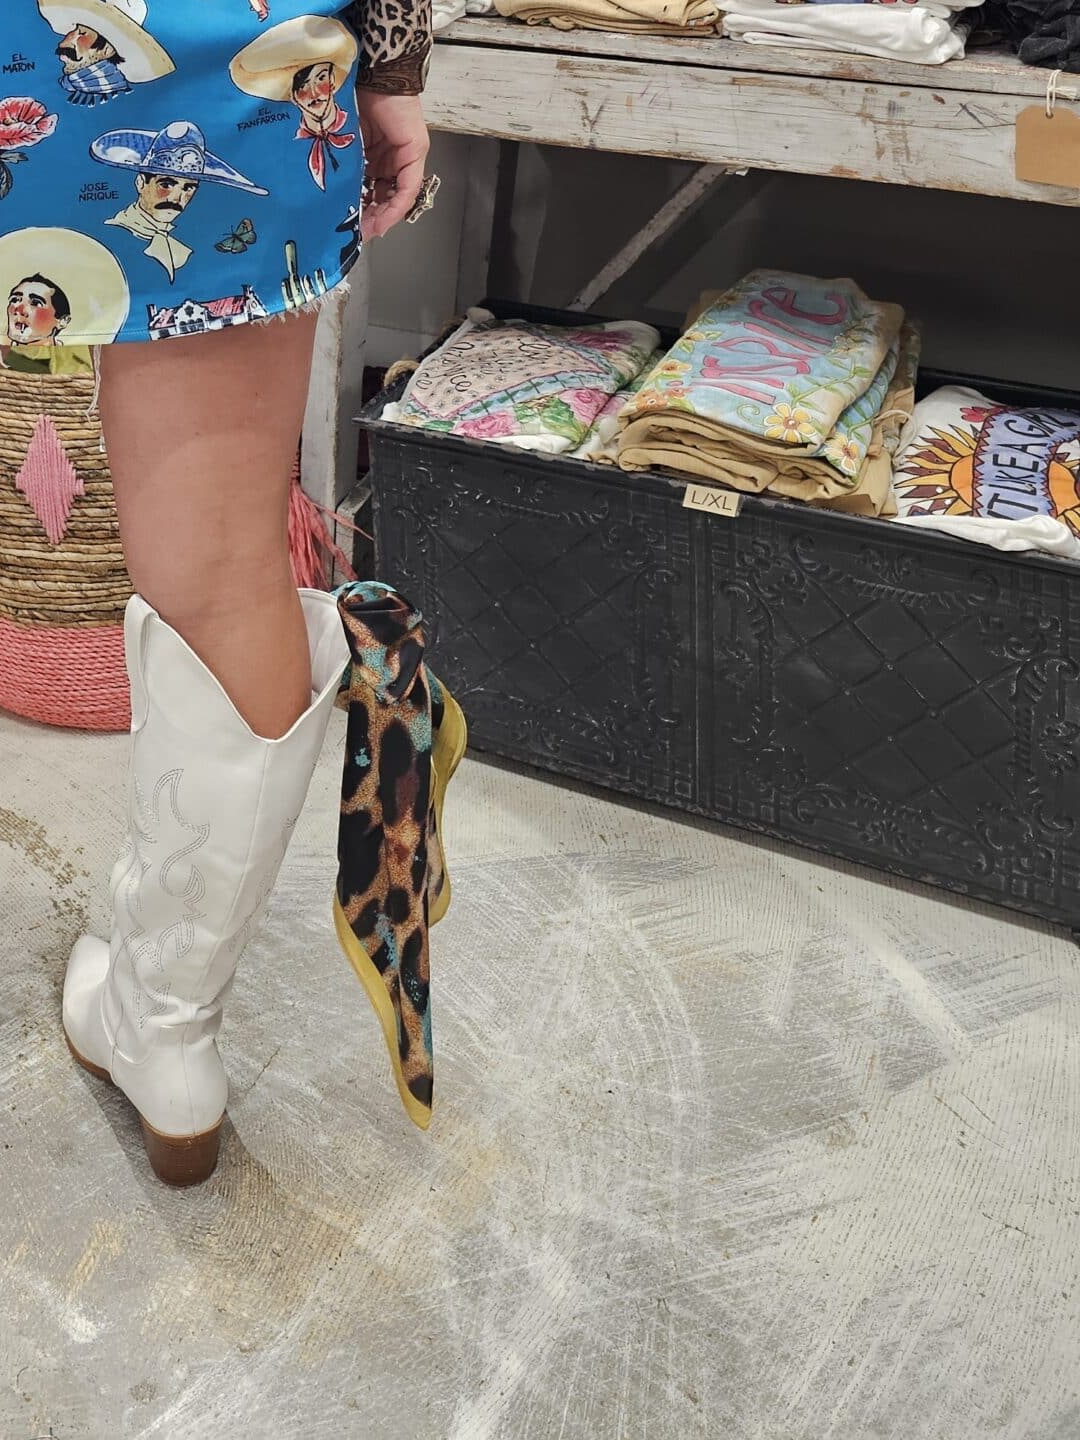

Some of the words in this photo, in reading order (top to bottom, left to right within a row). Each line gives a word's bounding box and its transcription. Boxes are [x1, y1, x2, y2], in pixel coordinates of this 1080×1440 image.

[11, 53, 28, 62] EL
[80, 181, 110, 193] JOSE
[691, 490, 732, 511] L/XL
